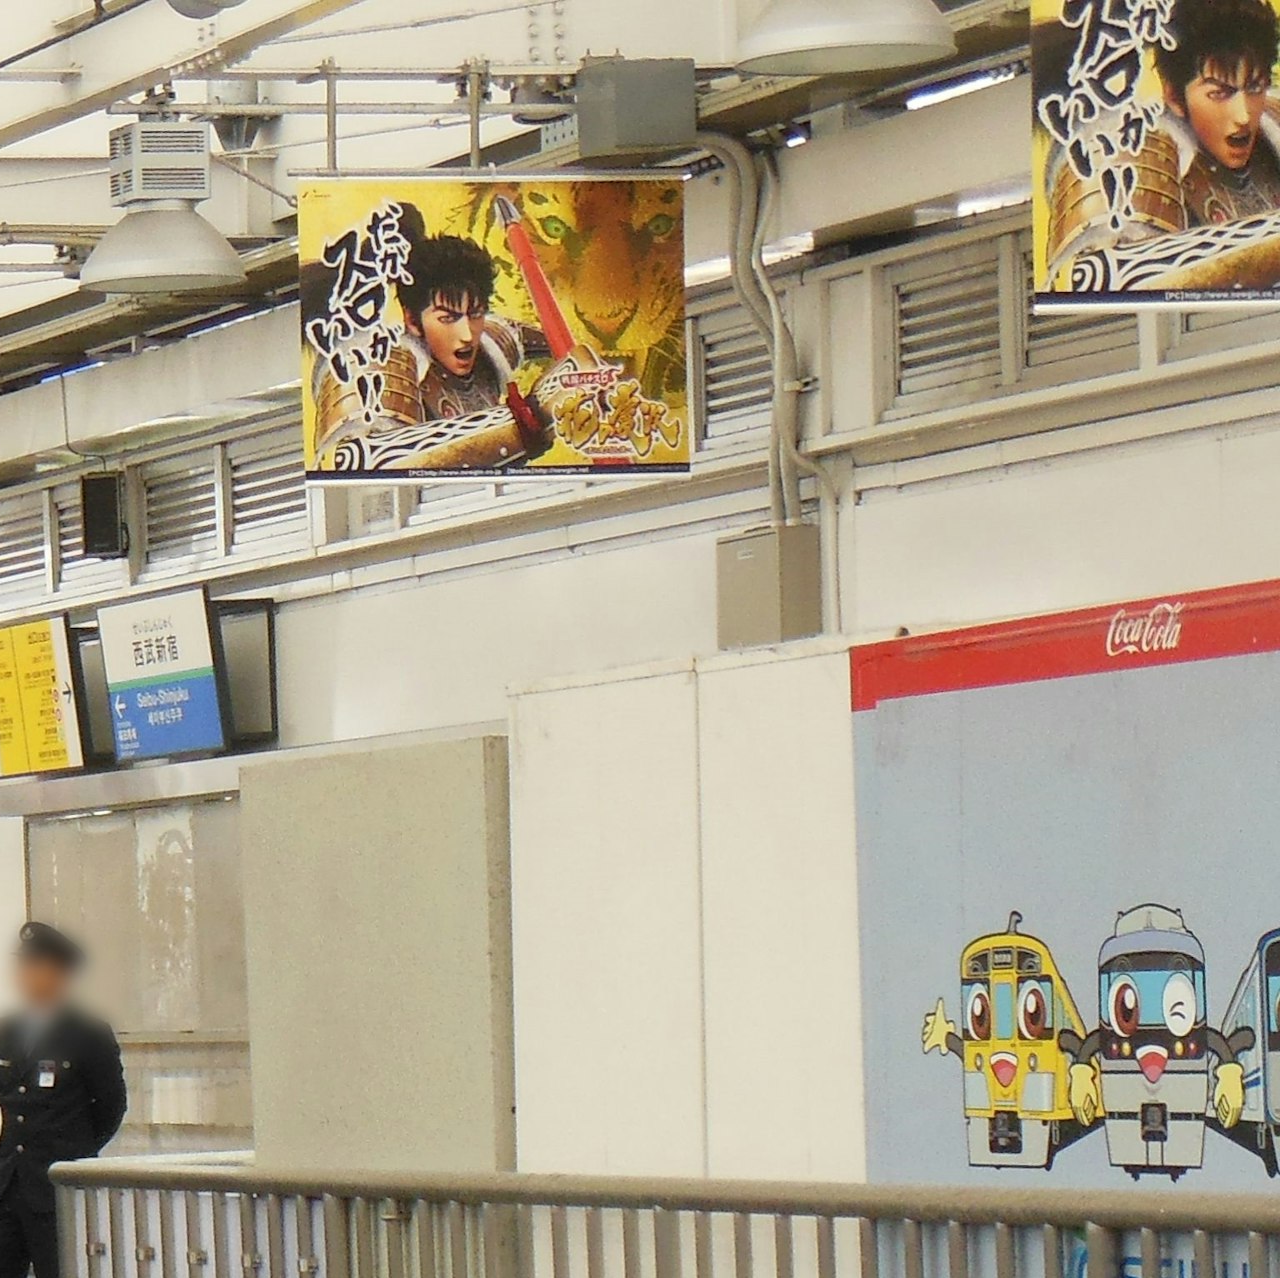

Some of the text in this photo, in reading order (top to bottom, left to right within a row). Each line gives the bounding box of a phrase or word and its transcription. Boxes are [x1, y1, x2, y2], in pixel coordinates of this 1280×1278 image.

[1128, 0, 1177, 51] が、
[132, 634, 179, 667] 西武新宿
